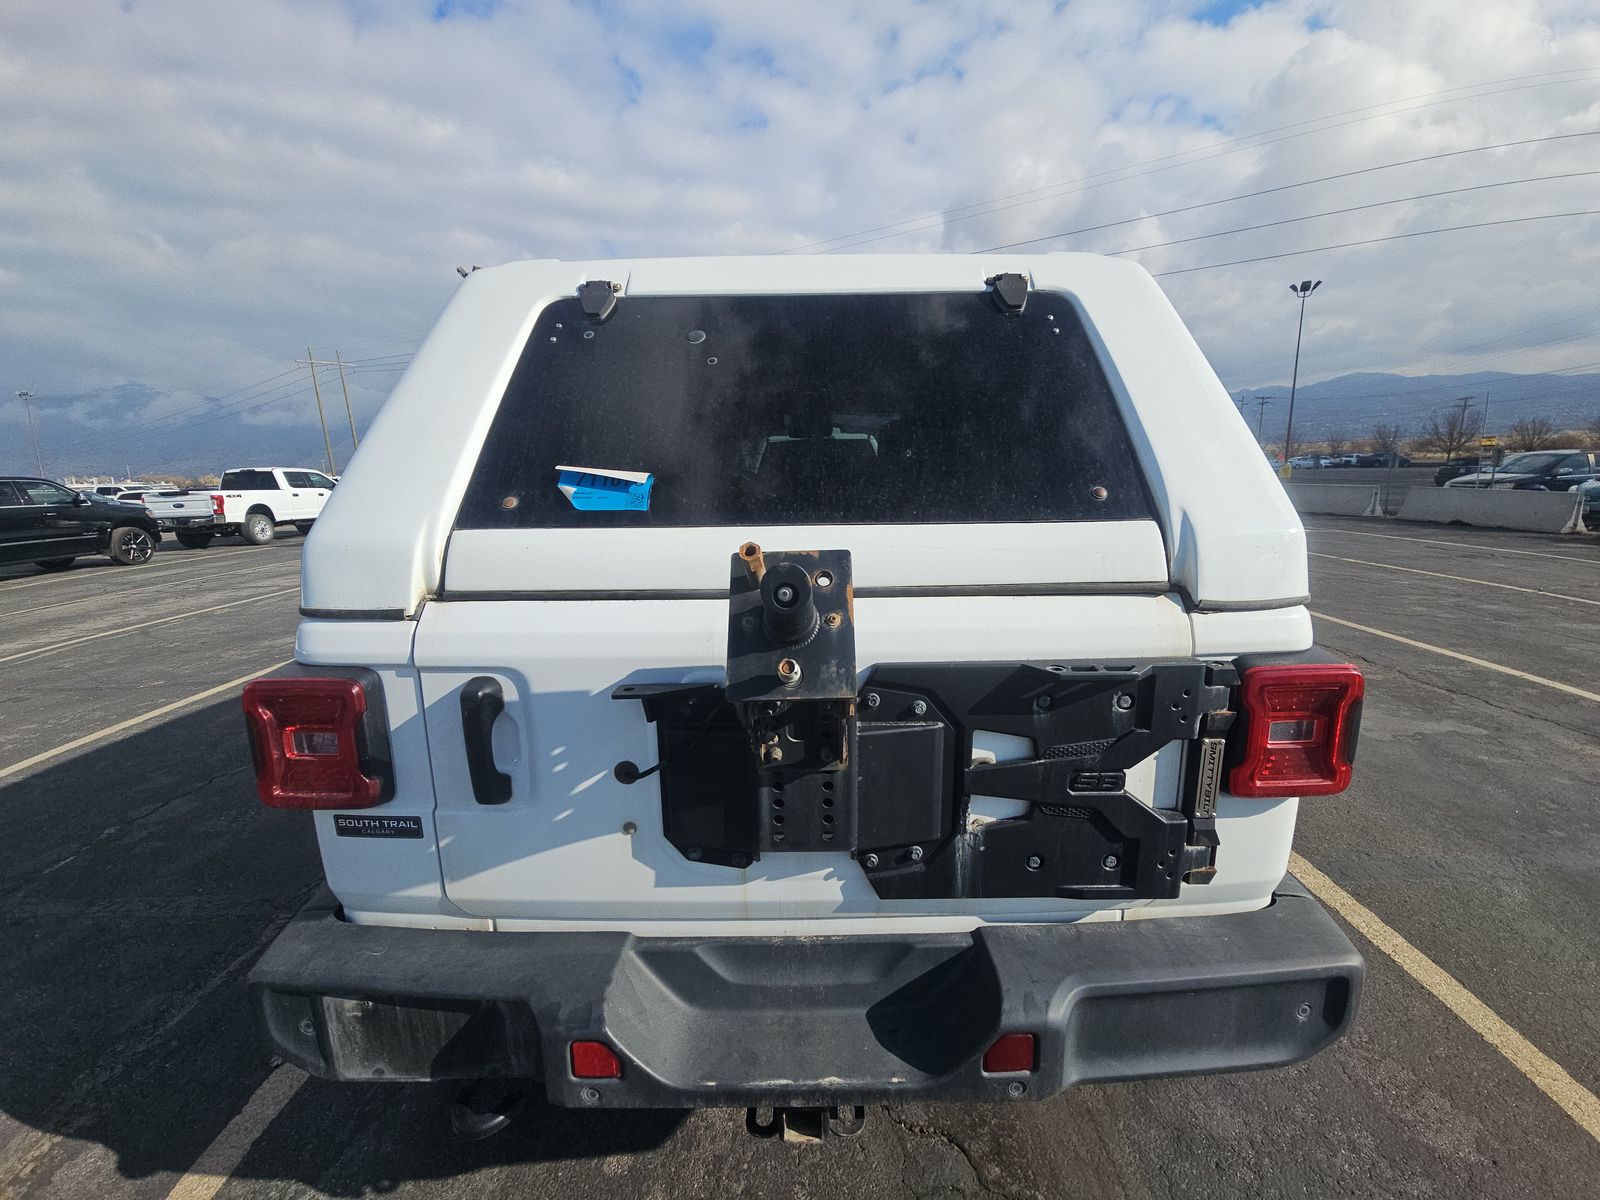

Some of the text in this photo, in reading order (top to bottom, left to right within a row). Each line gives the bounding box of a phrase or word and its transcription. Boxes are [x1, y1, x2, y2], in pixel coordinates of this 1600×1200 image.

[1203, 741, 1218, 815] SMITTYBILT
[338, 819, 418, 829] SOUTH TRAIL
